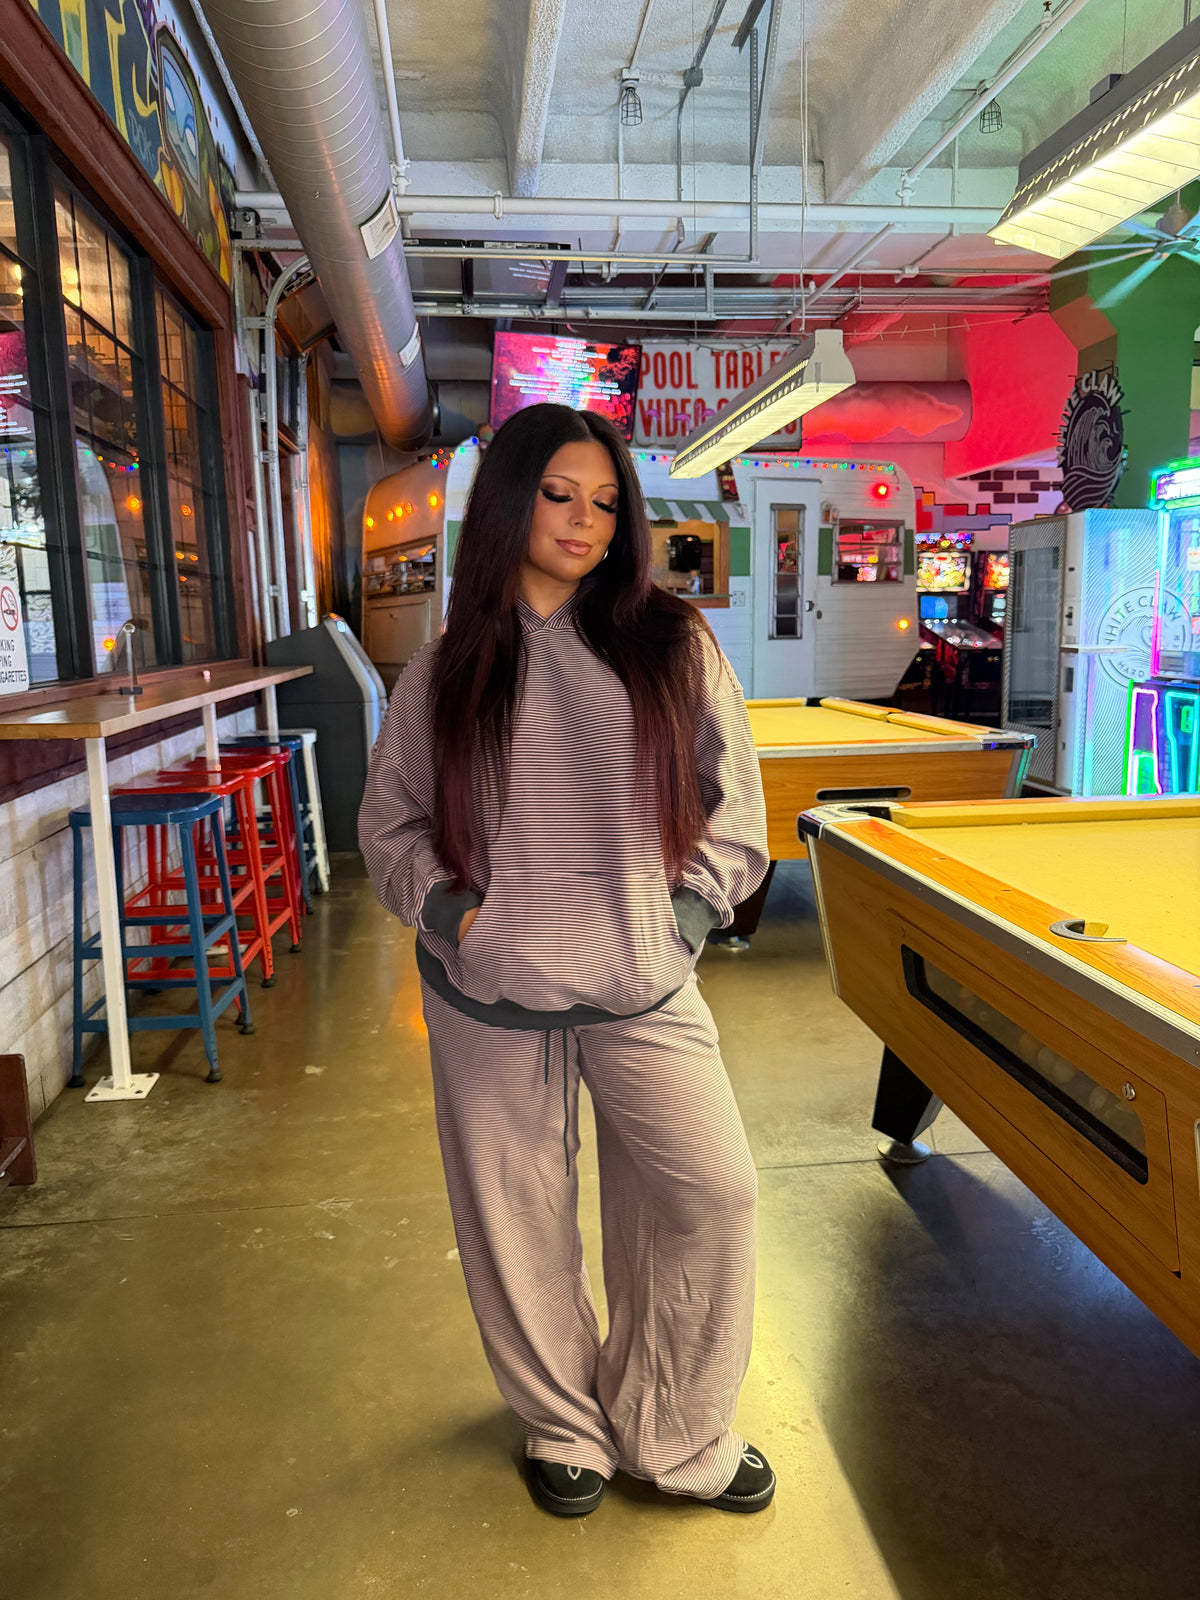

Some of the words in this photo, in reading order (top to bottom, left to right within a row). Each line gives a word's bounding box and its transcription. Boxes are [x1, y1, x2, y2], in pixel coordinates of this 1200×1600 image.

[639, 351, 698, 390] POOL
[1056, 386, 1080, 468] WHITE
[1081, 370, 1122, 407] CLAW
[1117, 661, 1145, 678] HARD
